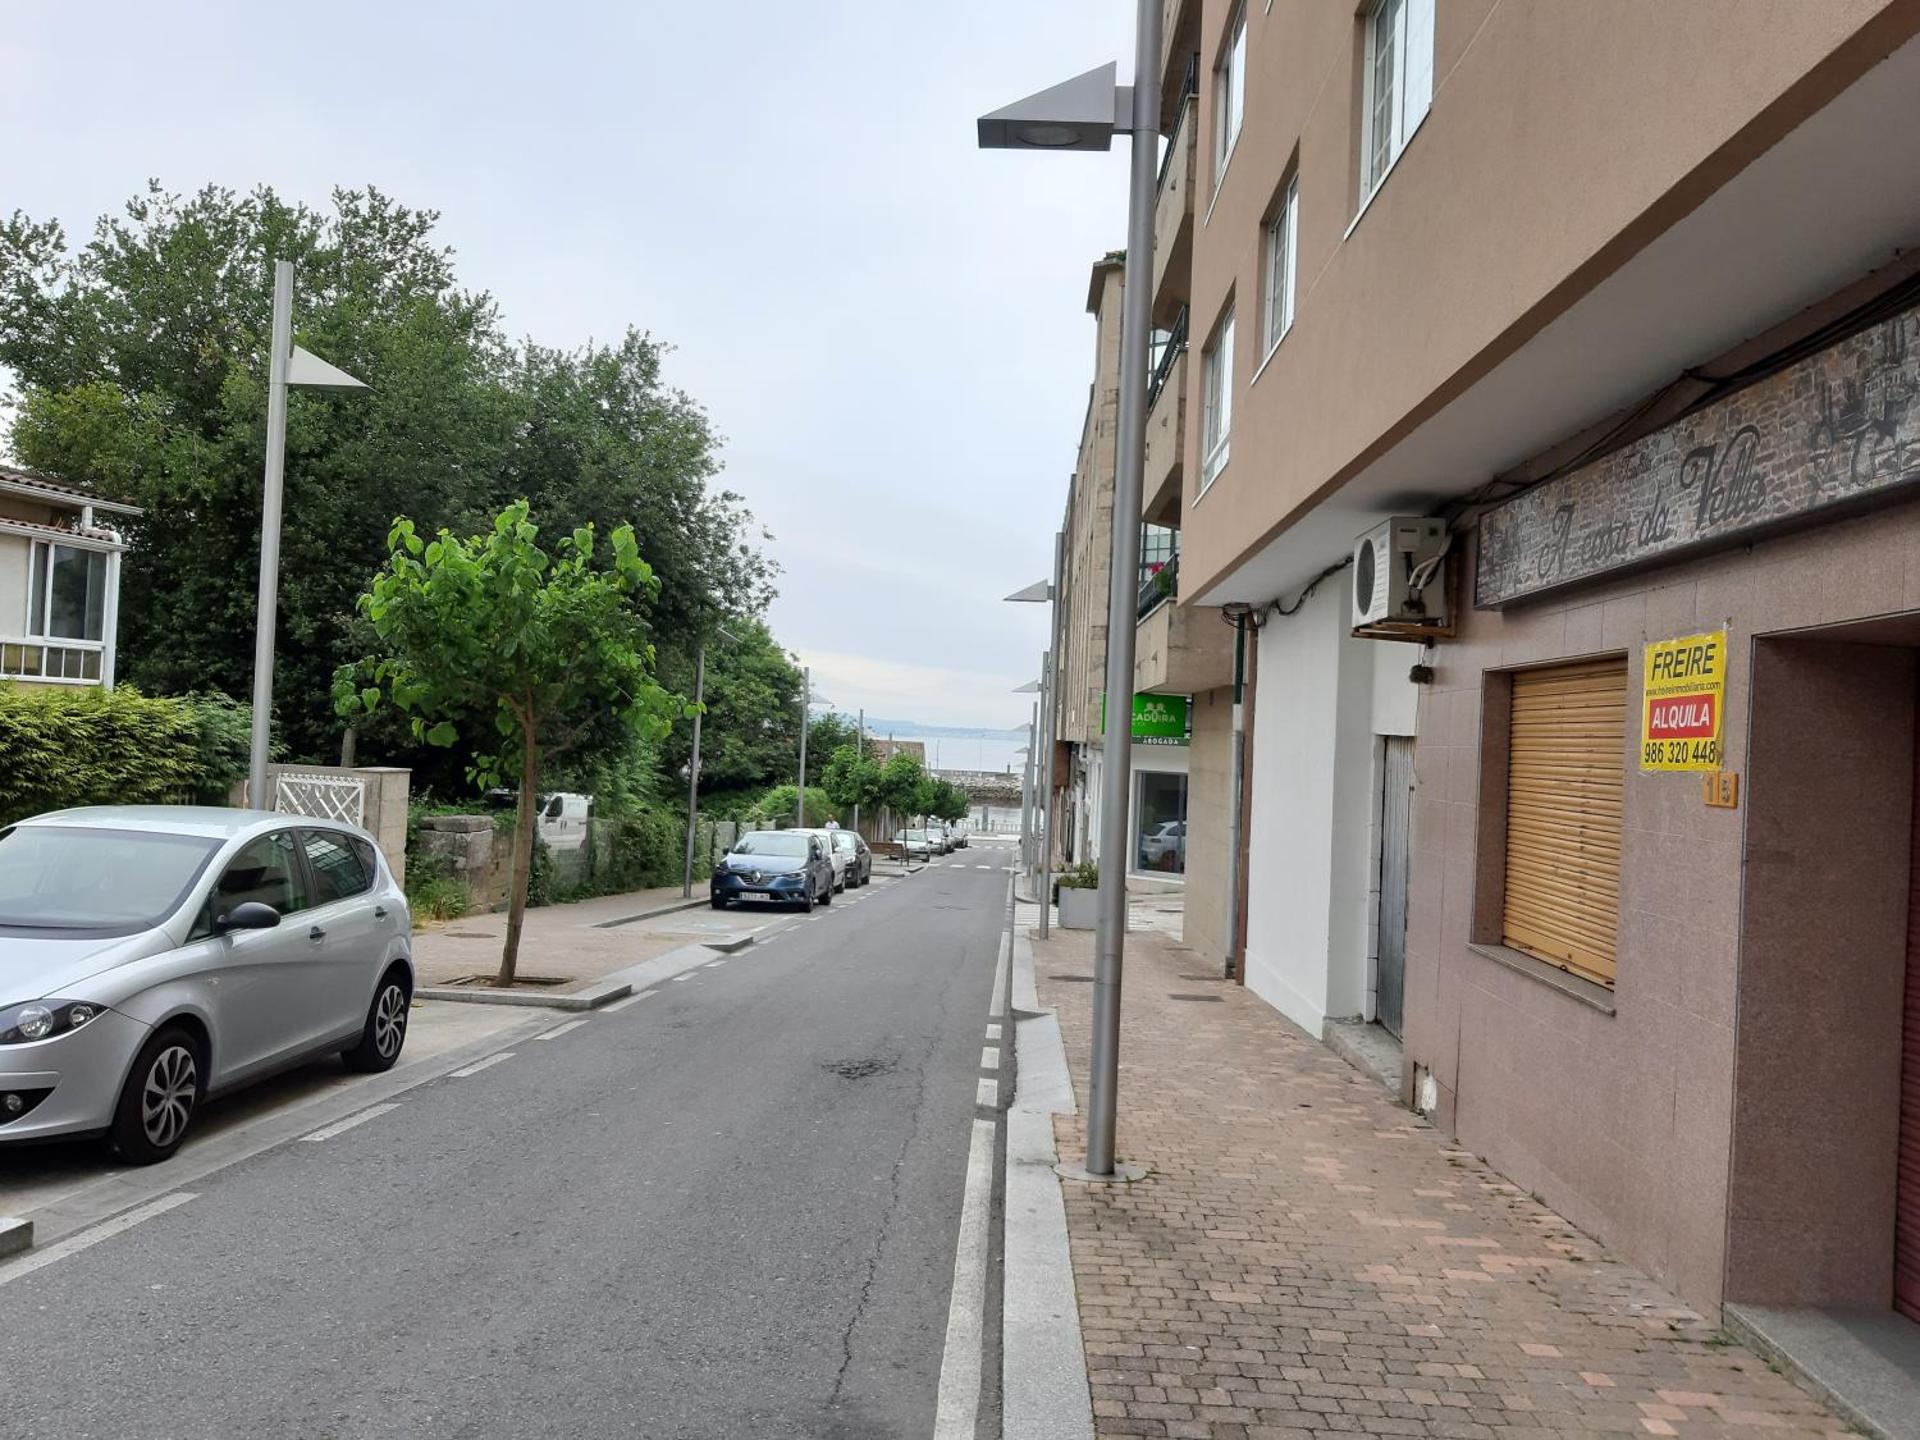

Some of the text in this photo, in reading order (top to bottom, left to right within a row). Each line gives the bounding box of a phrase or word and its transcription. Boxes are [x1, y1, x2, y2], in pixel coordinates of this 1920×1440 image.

[1680, 424, 1767, 532] Vella
[1651, 643, 1717, 681] FREIRE
[1652, 703, 1710, 730] ALQUILA
[1644, 741, 1716, 763] 986 320 448
